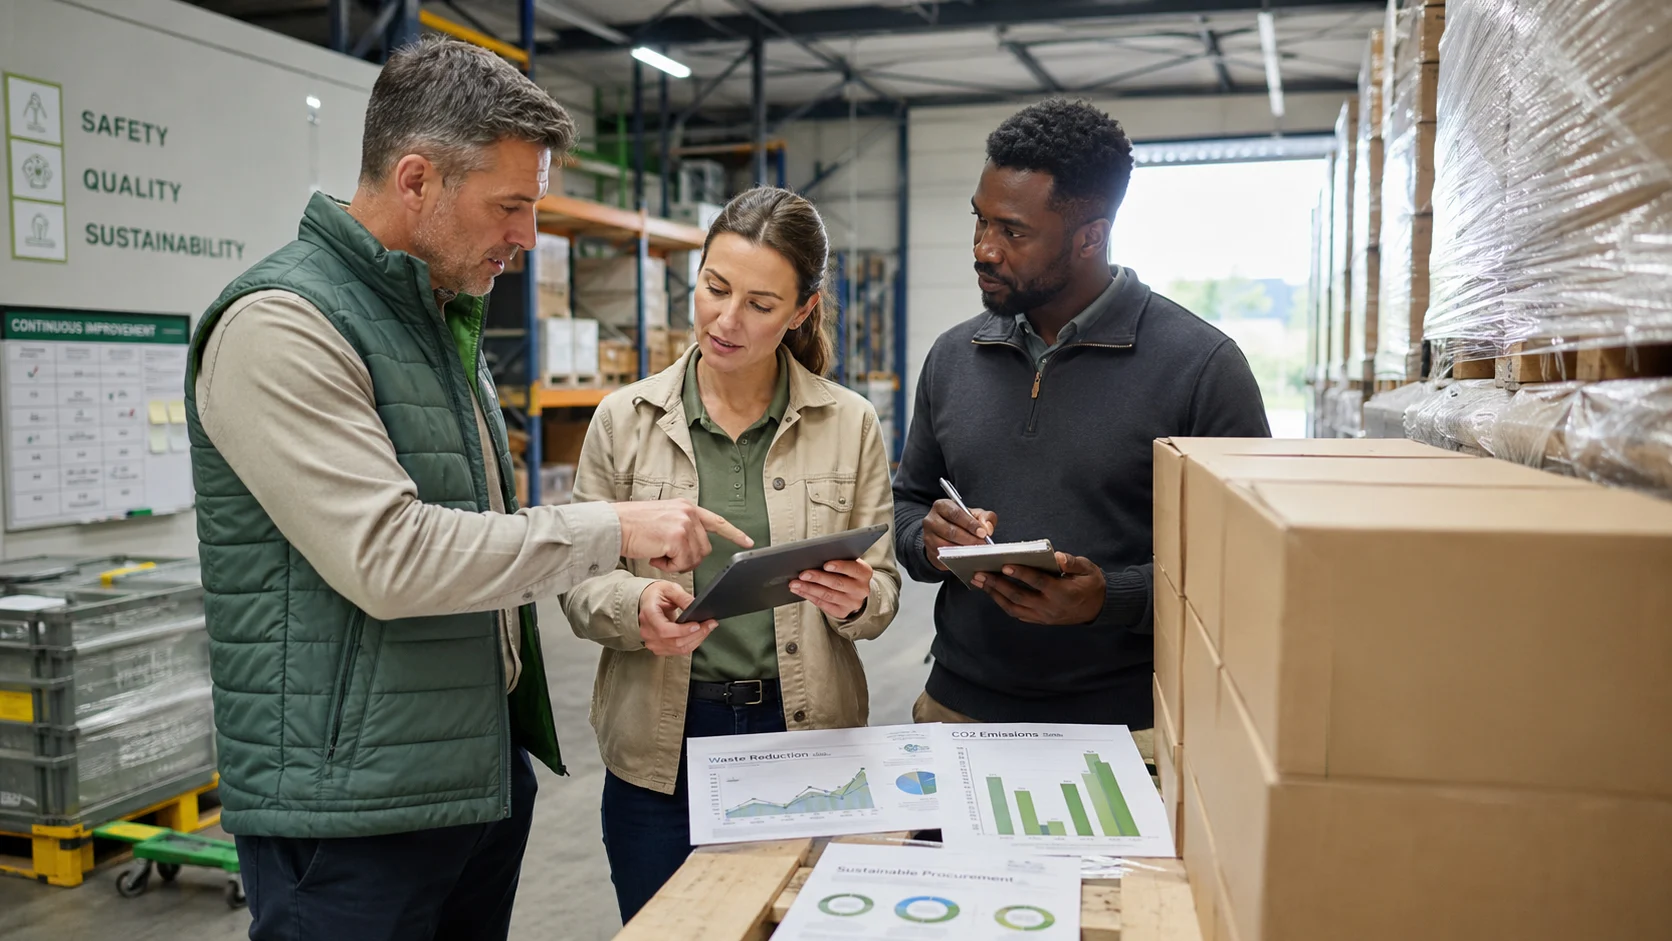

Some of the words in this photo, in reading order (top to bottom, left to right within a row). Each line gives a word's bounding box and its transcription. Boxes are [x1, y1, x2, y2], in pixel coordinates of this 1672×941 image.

[81, 110, 169, 147] SAFETY
[83, 168, 182, 204] QUALITY
[85, 222, 246, 260] SUSTAINABILITY
[11, 318, 83, 335] CONTINUOUS
[85, 321, 157, 337] IMPROVEMENT
[708, 755, 746, 763] Waste
[749, 751, 809, 761] Reduction
[836, 865, 918, 877] Sustainable
[922, 869, 1014, 883] Procurement
